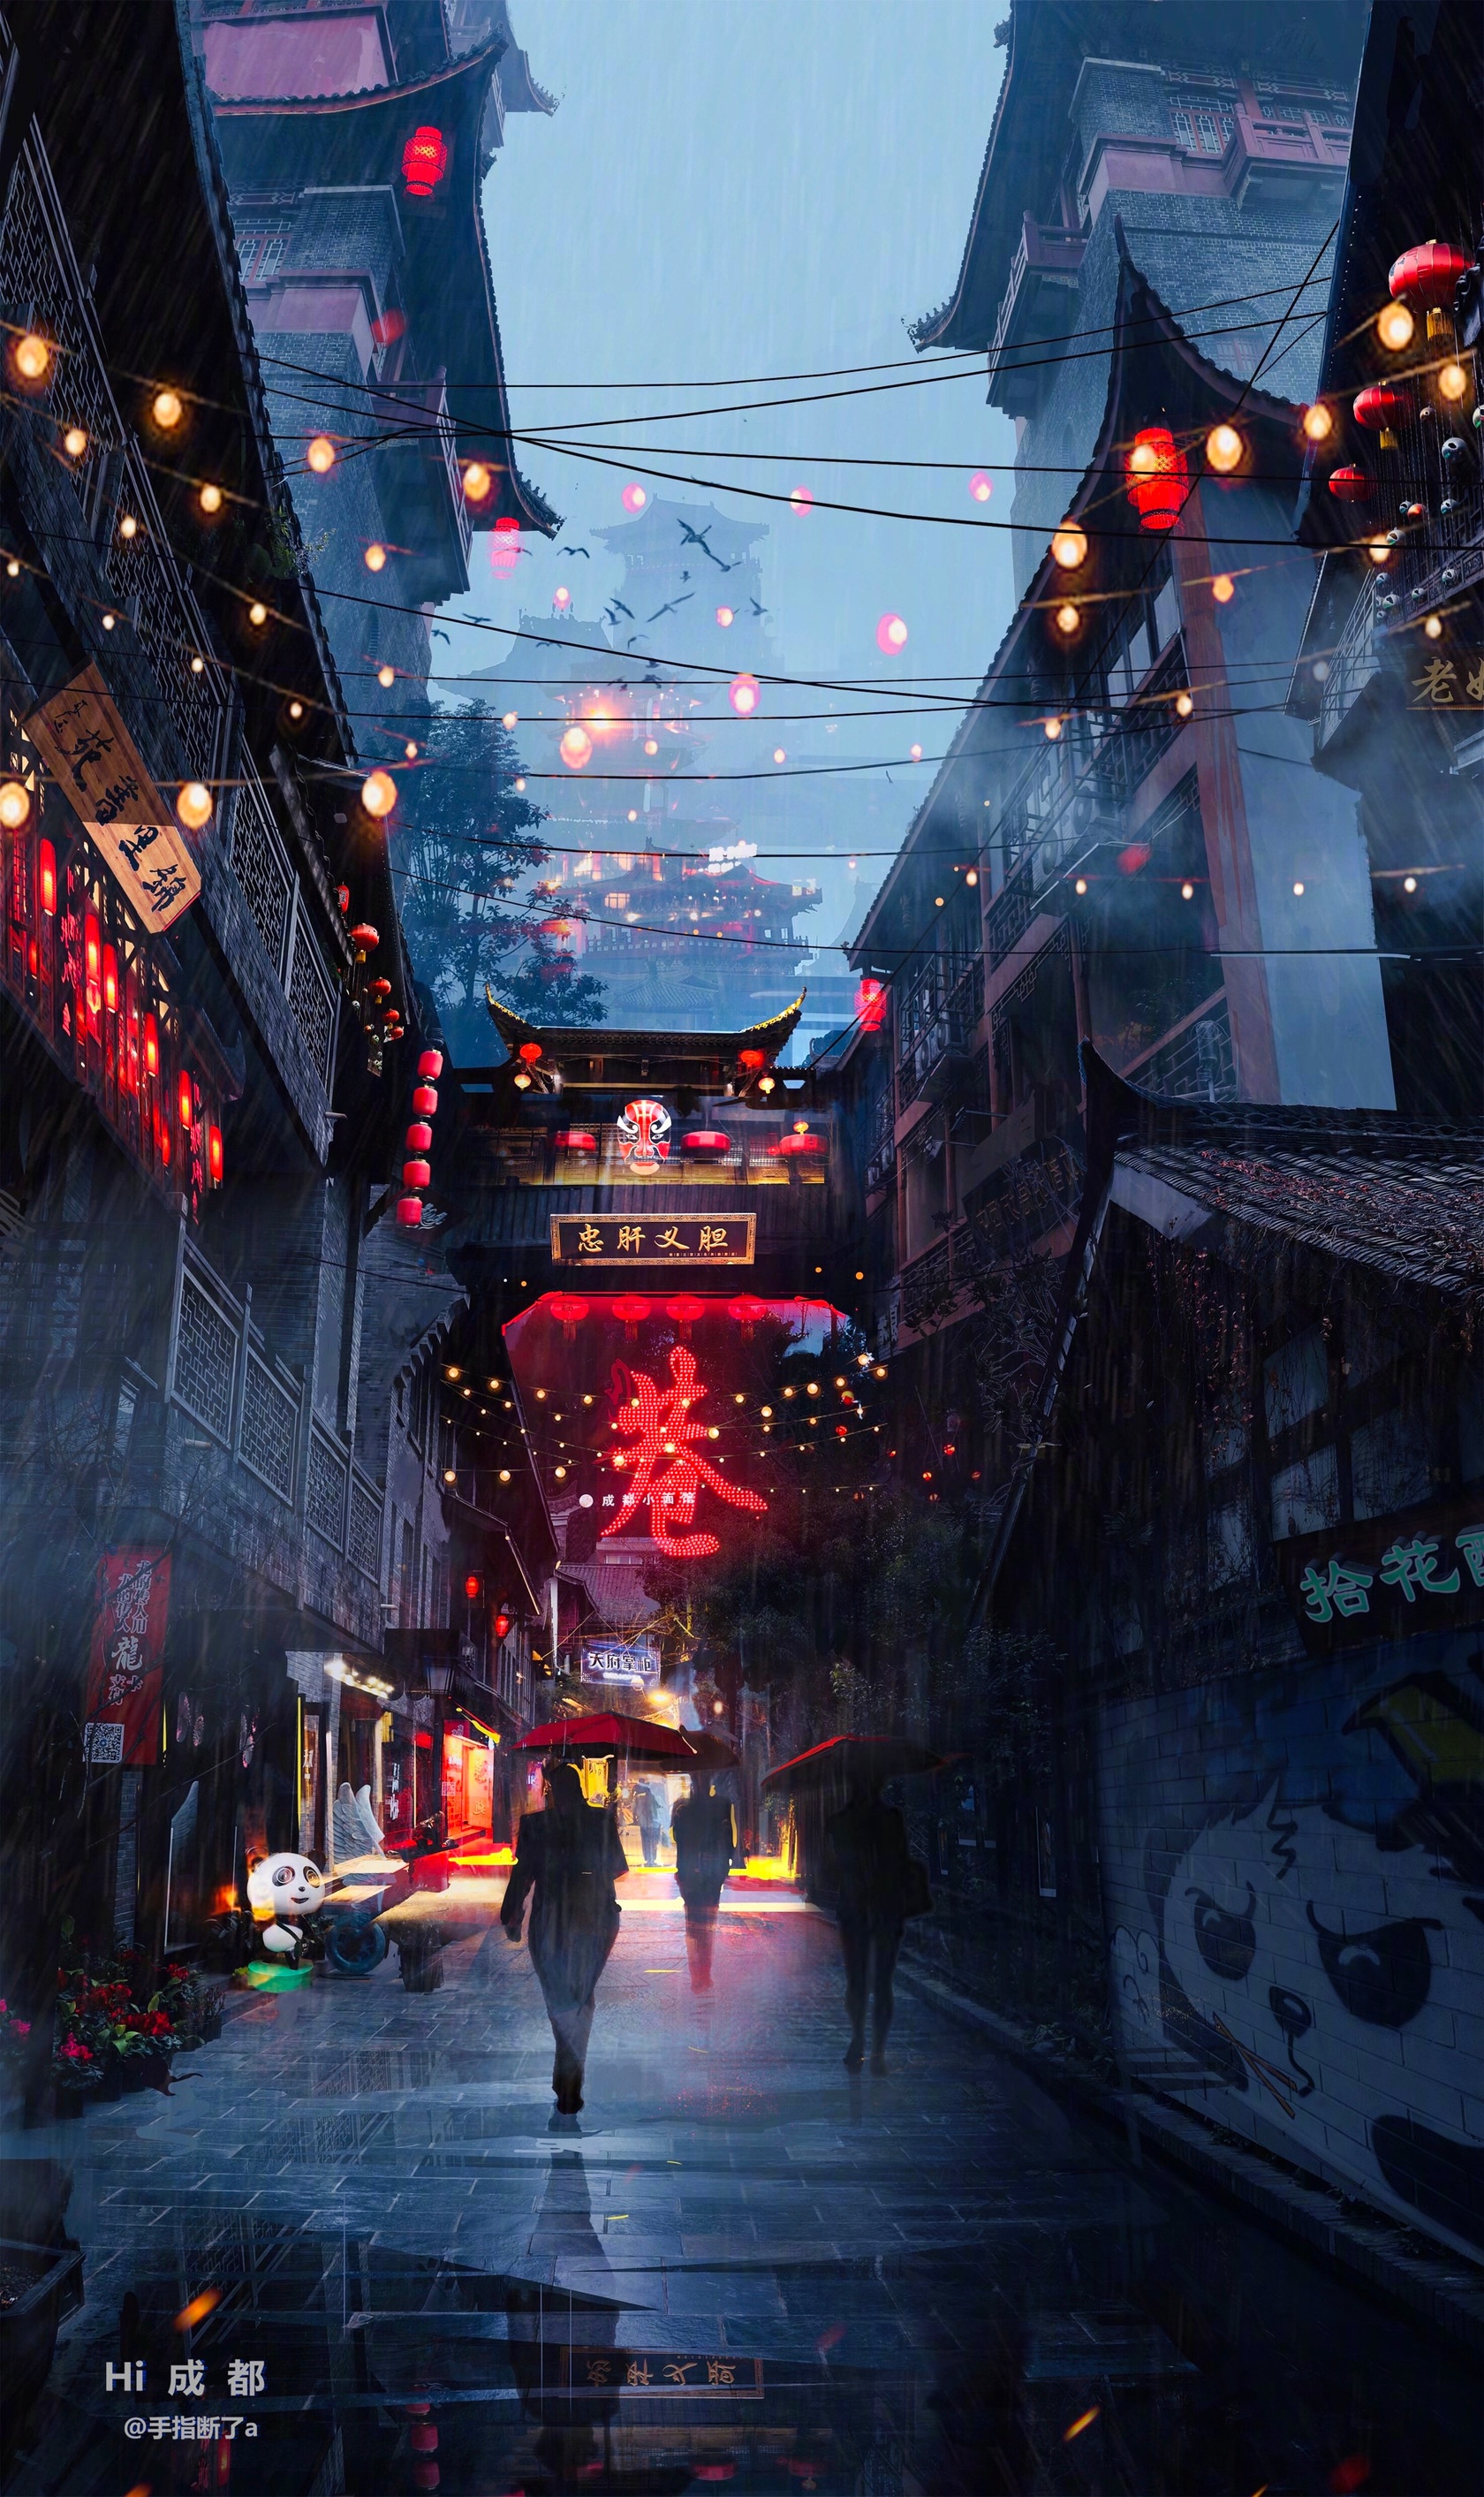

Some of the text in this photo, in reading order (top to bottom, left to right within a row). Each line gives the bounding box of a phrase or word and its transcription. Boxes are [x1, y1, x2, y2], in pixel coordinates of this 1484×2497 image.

[578, 1223, 729, 1254] 忠肝义胆
[589, 1651, 652, 1673] 天府掌柜
